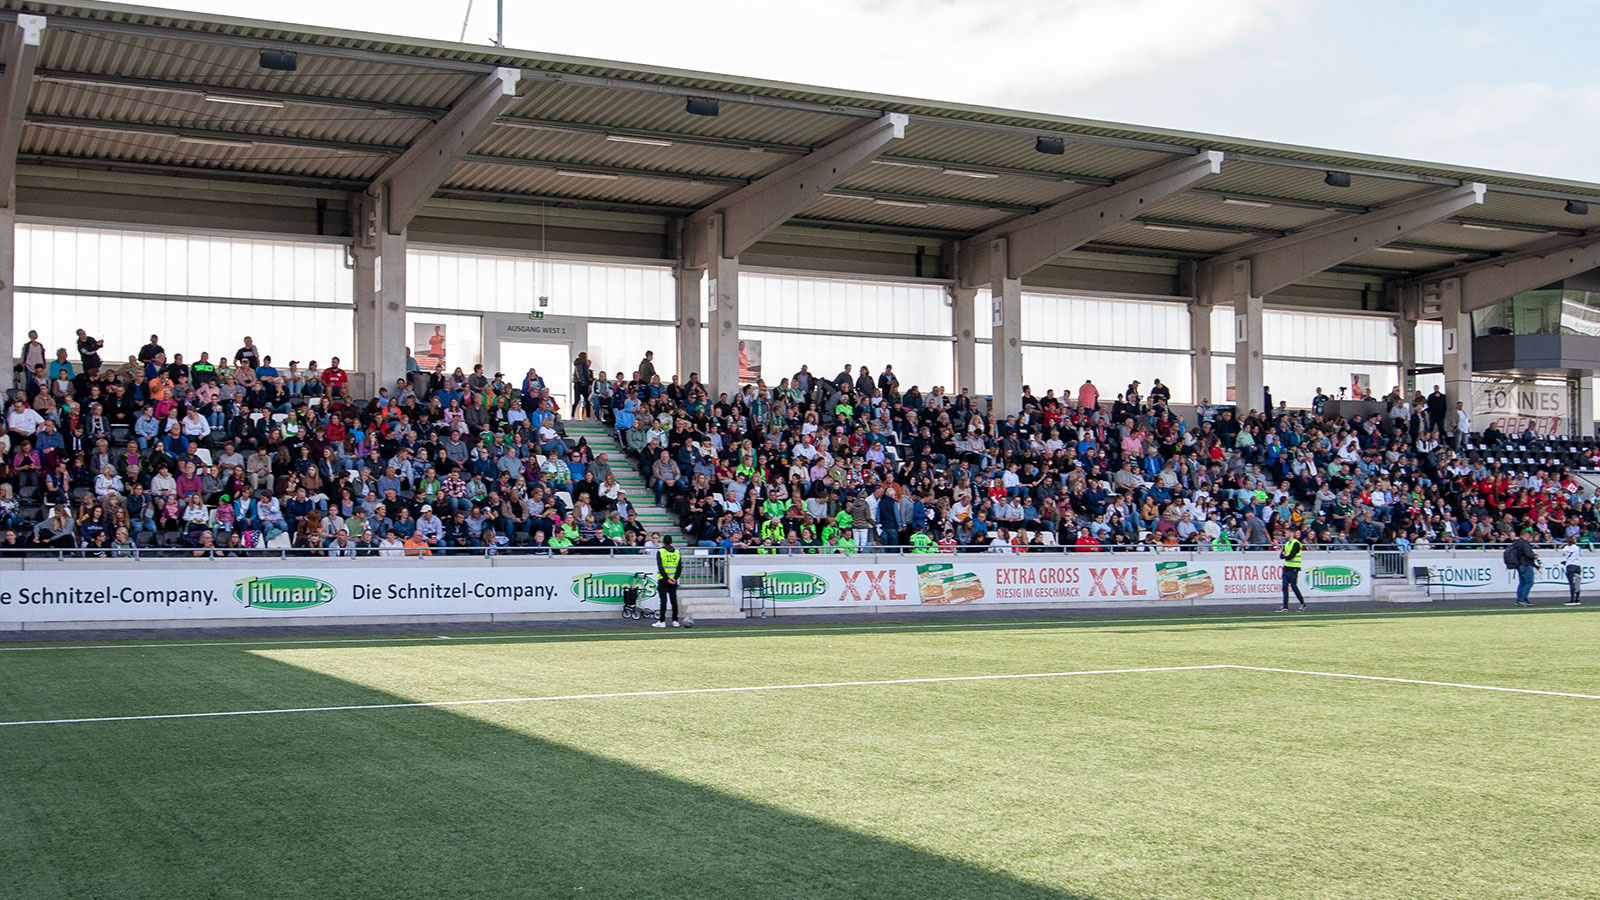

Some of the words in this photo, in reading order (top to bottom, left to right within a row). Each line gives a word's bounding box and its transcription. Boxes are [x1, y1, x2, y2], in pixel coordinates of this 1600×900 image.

[992, 301, 1002, 323] H
[507, 325, 541, 334] AUSGANG
[1447, 332, 1454, 351] J
[1484, 387, 1560, 411] TÖNNIES
[996, 568, 1036, 584] EXTRA
[1039, 567, 1080, 584] GROSS
[1224, 565, 1259, 581] EXTRA
[1261, 565, 1284, 580] GRO
[1305, 566, 1360, 590] Tillman's
[1437, 564, 1492, 582] TÖNNIES
[1545, 564, 1596, 580] TÖNES
[353, 584, 382, 600] Die
[387, 582, 558, 601] Schnitzel-Company.
[749, 571, 826, 597] illman's
[838, 569, 907, 601] XXL
[1088, 567, 1148, 597] XXL
[1224, 584, 1247, 594] RIESIG
[1248, 584, 1257, 593] IM
[18, 586, 218, 606] Schnitzel-Company.
[234, 576, 333, 608] Tillman's
[996, 588, 1021, 599] RIESIG
[1023, 588, 1033, 598] IM
[1034, 587, 1080, 598] GESCHMACK
